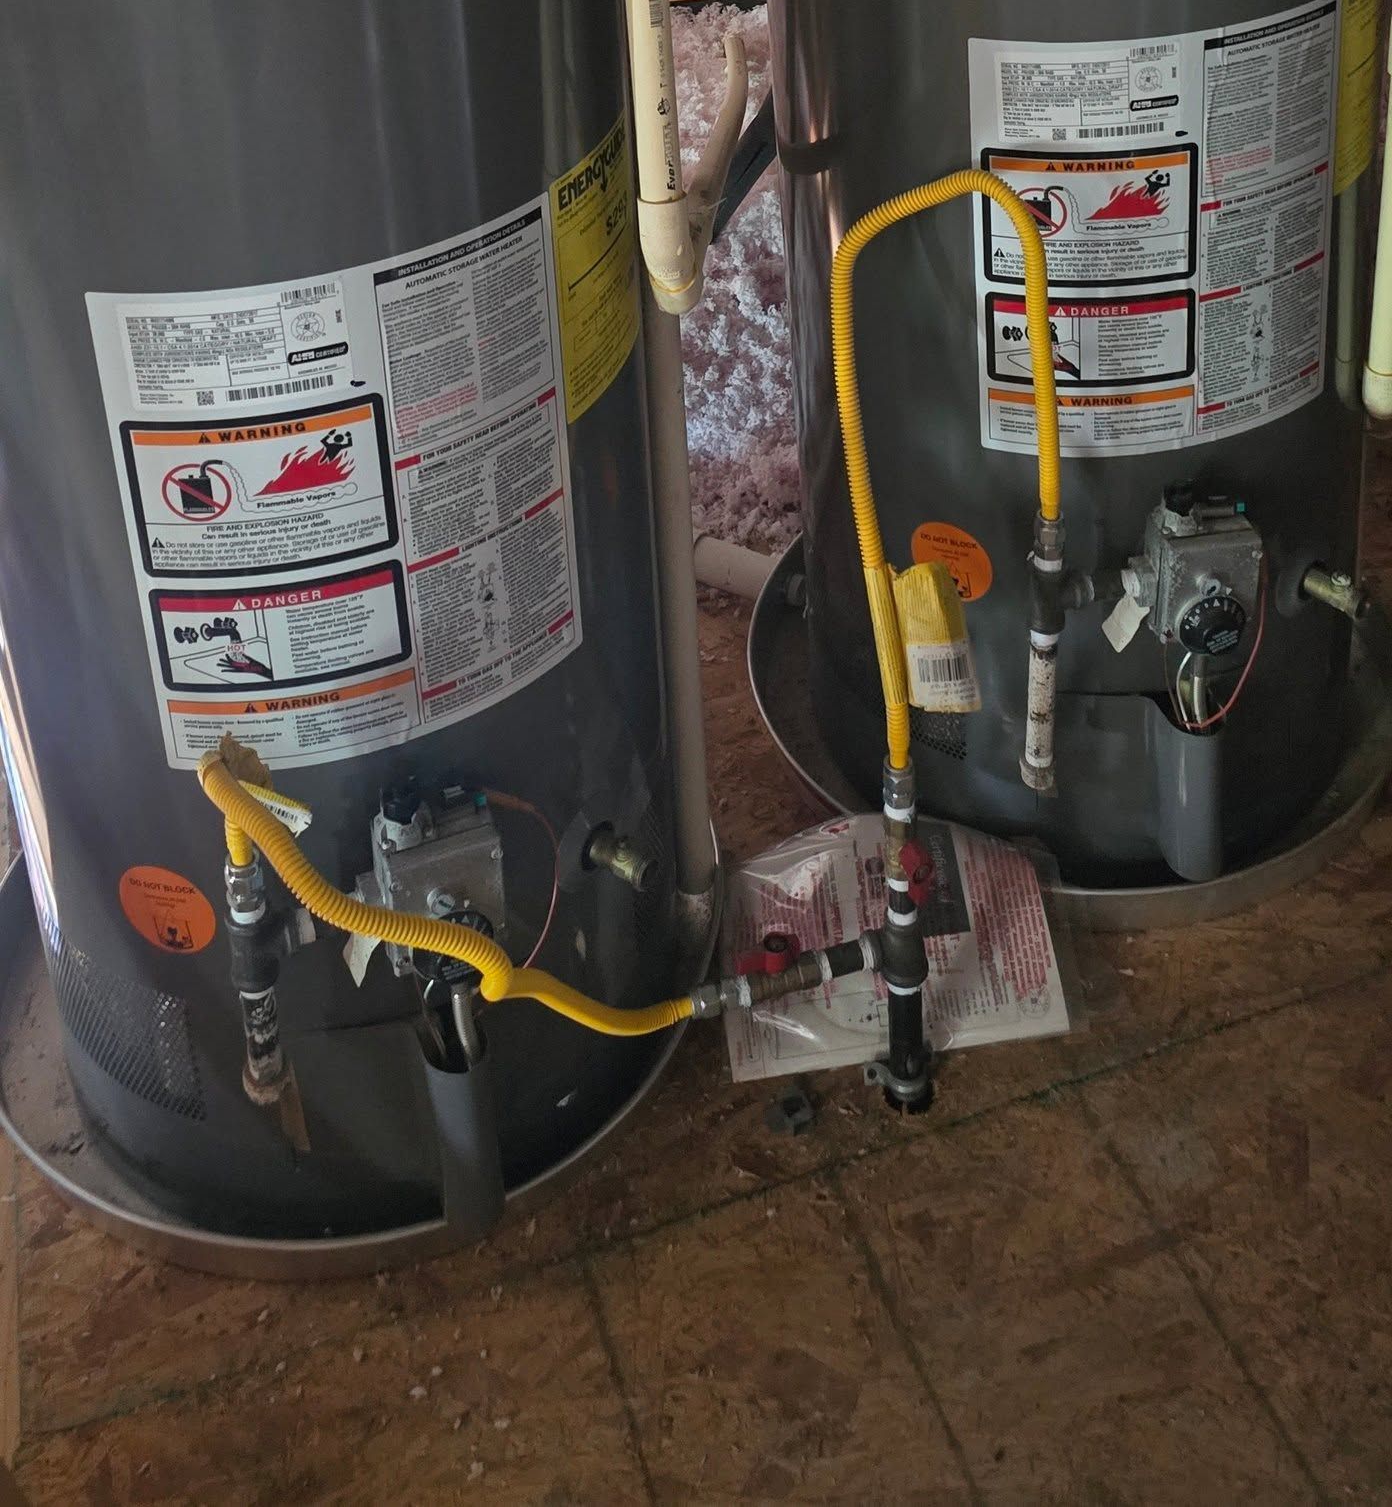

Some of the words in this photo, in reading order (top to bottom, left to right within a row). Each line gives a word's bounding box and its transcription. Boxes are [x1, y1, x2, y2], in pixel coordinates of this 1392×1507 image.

[1063, 160, 1135, 172] WARNING
[1086, 224, 1126, 232] Flammable
[1126, 222, 1153, 230] Vapors
[397, 254, 450, 277] INSTALLATION
[450, 245, 466, 259] AND
[465, 231, 502, 253] OPERATION
[405, 269, 447, 290] AUTOMATIC
[447, 257, 479, 276] STORAGE
[478, 247, 501, 263] WATER
[500, 235, 524, 253] HEATER
[1070, 305, 1130, 316] DANGER
[1071, 395, 1132, 408] WARNING
[218, 422, 307, 444] WARNING
[423, 450, 436, 462] FOR
[436, 444, 452, 457] YOUR
[452, 435, 475, 450] SAFETY
[256, 495, 305, 510] Flammable
[306, 490, 337, 503] Vapors
[206, 525, 225, 533] FIRE
[226, 523, 244, 532] AND
[244, 518, 289, 530] EXPLOSION
[290, 513, 325, 524] HAZARD
[217, 531, 239, 539] result
[249, 529, 276, 537] serious
[278, 525, 299, 535] injury
[310, 519, 332, 529] death
[920, 533, 931, 541] DO
[932, 535, 948, 544] NOT
[950, 538, 978, 549] BLOCK
[251, 589, 323, 609] DANGER
[227, 643, 247, 653] HOT
[265, 692, 341, 712] WARNING
[129, 877, 142, 887] DO
[142, 880, 161, 890] NOT
[162, 884, 196, 895] BLOCK
